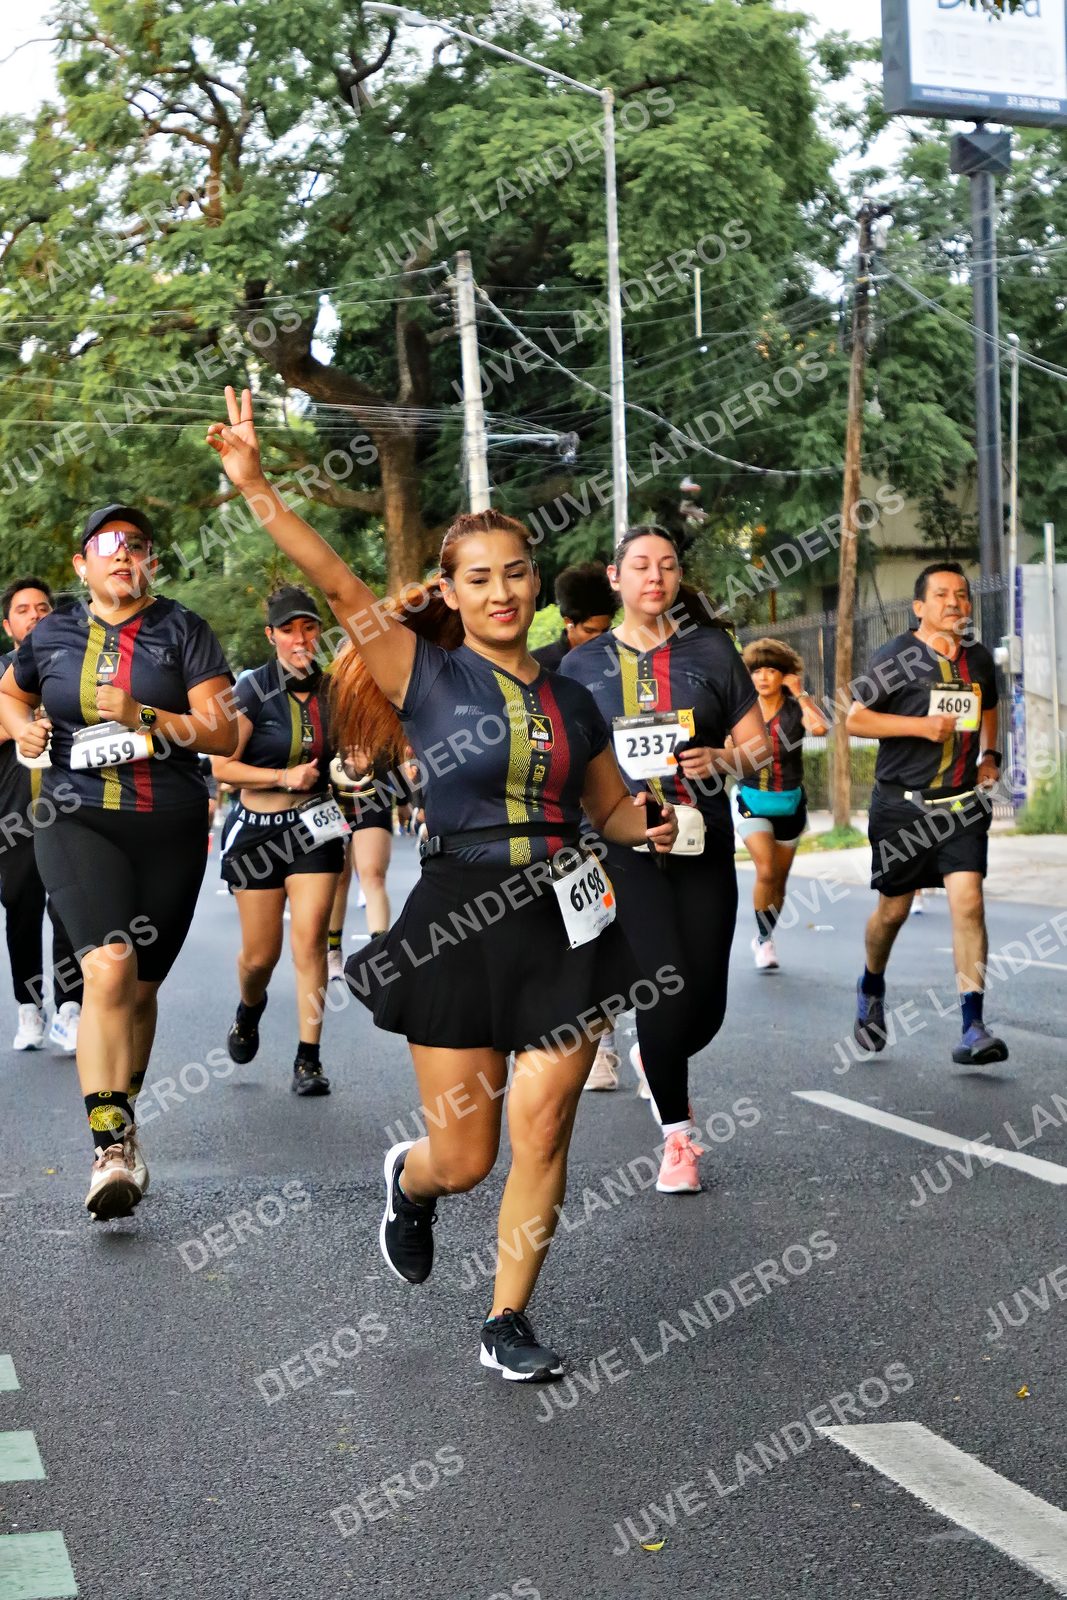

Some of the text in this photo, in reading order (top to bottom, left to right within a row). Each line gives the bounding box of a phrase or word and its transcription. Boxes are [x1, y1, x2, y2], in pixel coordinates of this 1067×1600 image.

[937, 697, 971, 713] 4609
[81, 740, 135, 768] 1559
[626, 733, 677, 758] 2337
[238, 810, 295, 826] ARMOU
[313, 805, 342, 828] 6565
[570, 867, 605, 912] 6198
